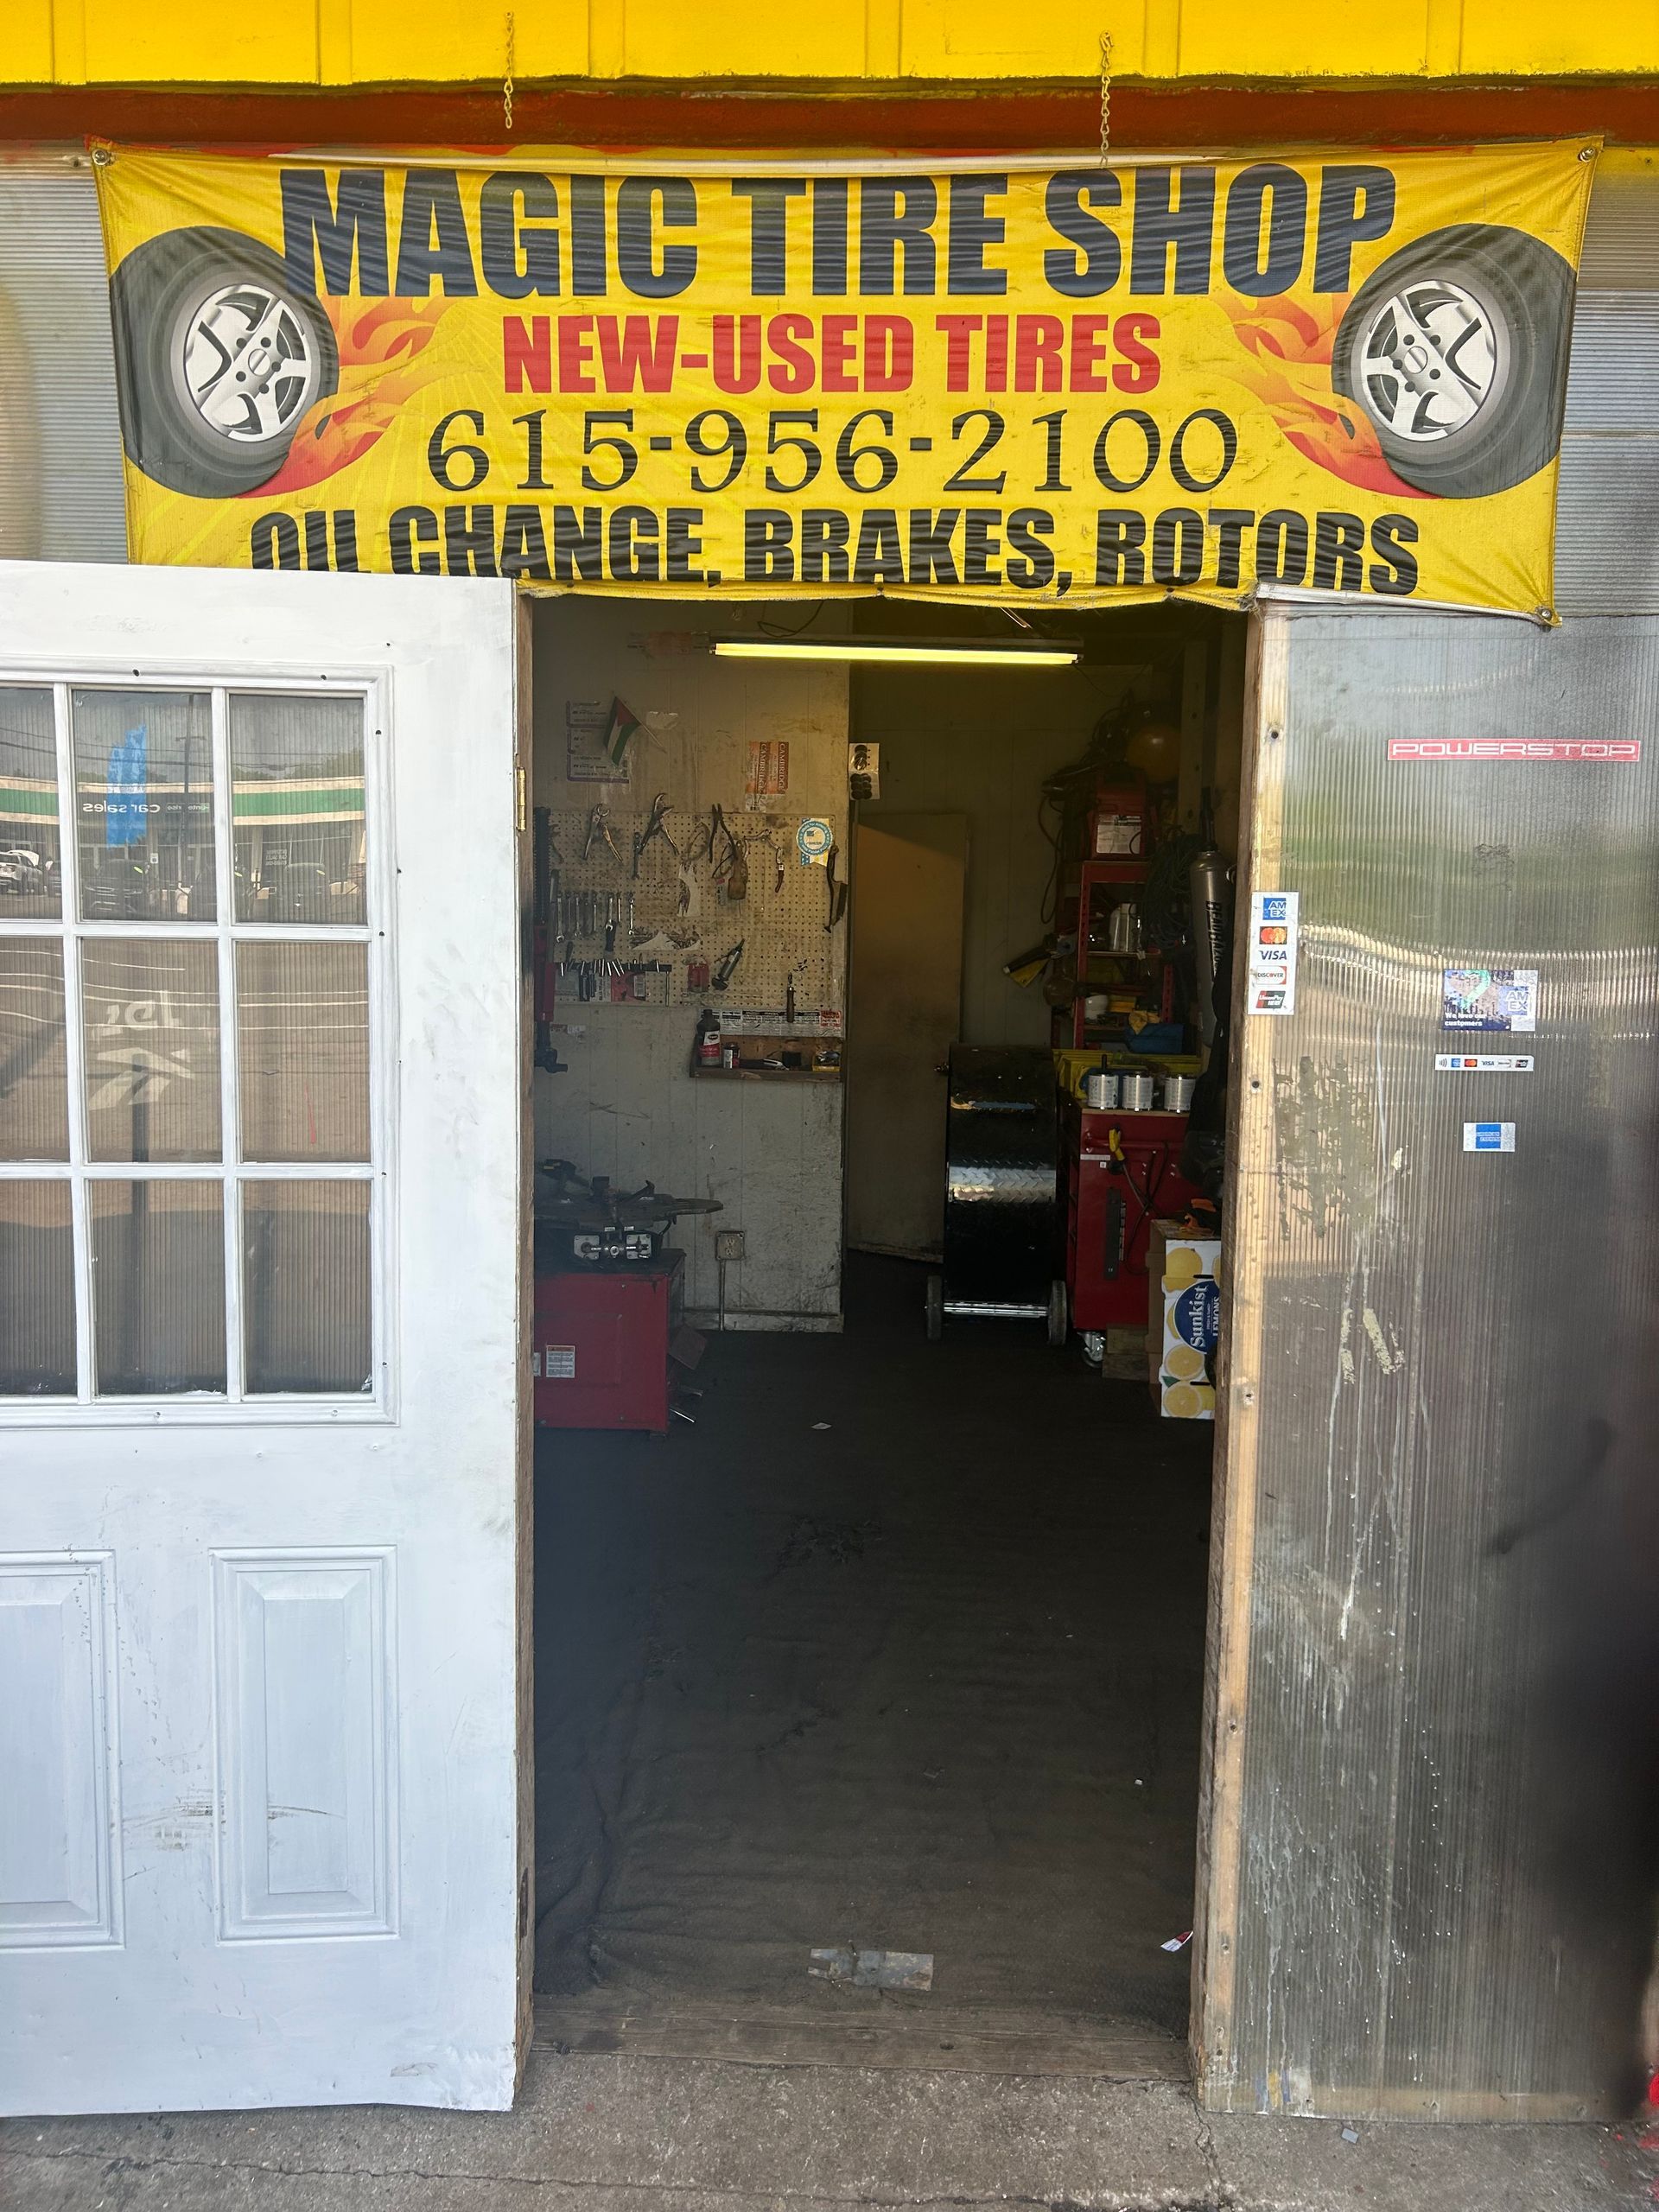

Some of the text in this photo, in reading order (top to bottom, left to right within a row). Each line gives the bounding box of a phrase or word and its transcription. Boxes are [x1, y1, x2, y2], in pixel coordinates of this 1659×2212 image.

[280, 162, 1396, 299] MAGIC TIRE SHOP
[504, 313, 1161, 394] NEW-USED TIRES
[428, 409, 1237, 494] 615-956-2100
[251, 505, 1419, 598] OIL CHANGE, BRAKES, ROTORS
[1392, 742, 1636, 757] POWERSTOP
[1258, 950, 1287, 960] VISA
[1189, 1285, 1209, 1347] Sunkist
